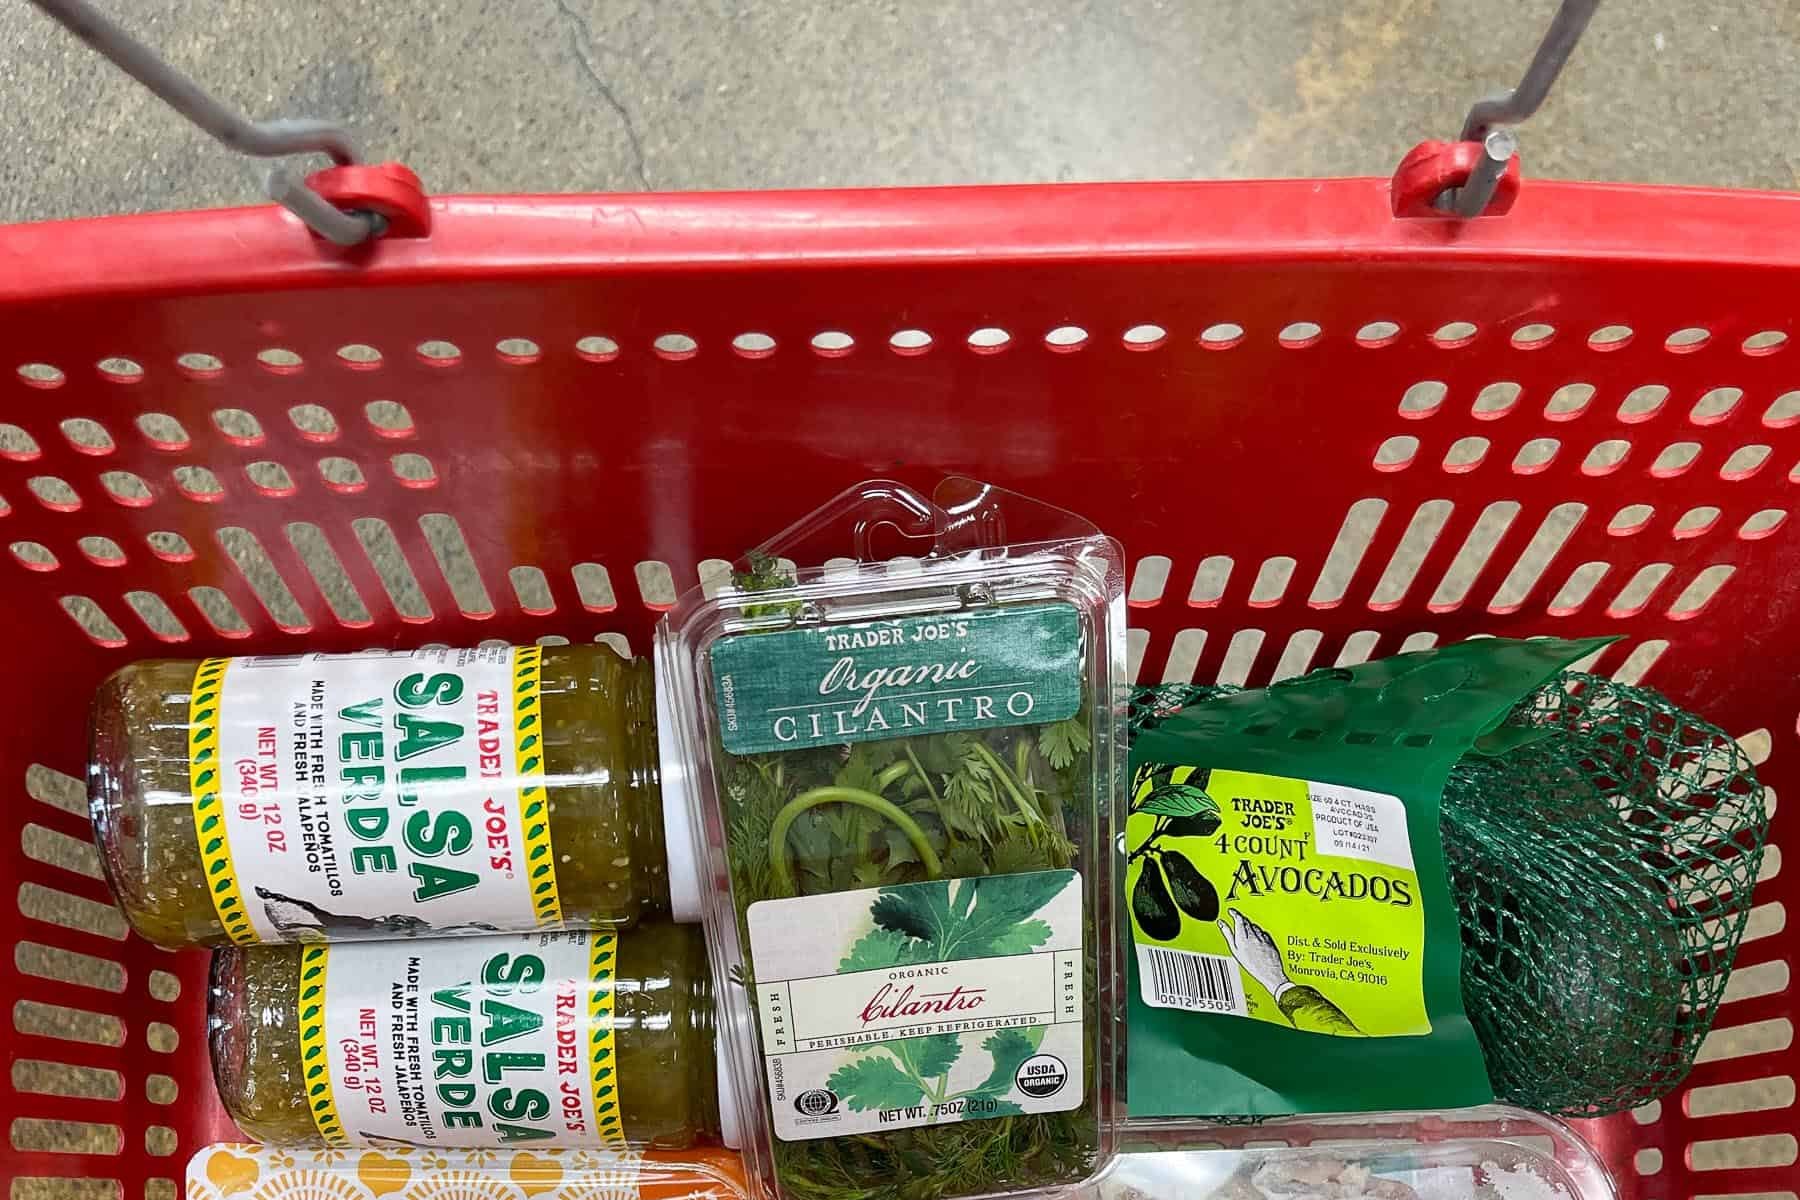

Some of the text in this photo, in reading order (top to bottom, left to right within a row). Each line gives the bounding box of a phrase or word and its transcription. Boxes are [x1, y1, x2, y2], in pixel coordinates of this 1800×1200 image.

[826, 621, 969, 652] TRADER JOE'S
[312, 680, 325, 709] MADE
[818, 645, 983, 717] Organic
[773, 690, 1035, 742] CILANTRO
[294, 702, 308, 781] AND FRESH
[257, 727, 287, 853] NET 12 OZ
[337, 698, 398, 876] VERDE
[395, 671, 481, 903] SALSA
[1231, 798, 1296, 817] TRADER
[1315, 813, 1352, 827] PRODUCT
[316, 812, 343, 897] TOMATILLOS
[1214, 833, 1308, 861] 4 COUNT
[1224, 859, 1413, 907] AVOCADOS
[889, 966, 949, 980] ORGANIC
[1287, 950, 1344, 964] By: Trader
[1312, 938, 1321, 948] &
[1324, 938, 1347, 951] Sold
[1350, 941, 1410, 960] Exclusively
[1063, 960, 1074, 1015] FRESH
[1289, 963, 1388, 985] Monrovia, CA 91016
[770, 993, 786, 1046] FRESH
[857, 982, 987, 1028] Cilantro
[899, 1016, 1041, 1038] KEEP REFRIGERATED.
[1161, 994, 1192, 1008] 0012
[1199, 1000, 1231, 1011] 5505
[339, 1039, 364, 1089] (340 g)
[360, 1008, 386, 1113] NET WT. 12 OZ
[391, 982, 417, 1127] AND FRESH JALAPEÑOS
[406, 956, 437, 1139] MADE WITH FRESH TOMATILLOS
[430, 981, 484, 1129] VERDE
[480, 952, 557, 1143] SALSA
[1027, 1064, 1056, 1075] USDA
[560, 1080, 585, 1132] JOE'S
[1024, 1077, 1060, 1087] ORGANIC
[879, 1110, 901, 1123] NET
[905, 1106, 926, 1119] WT.
[967, 1099, 998, 1112] (21g)
